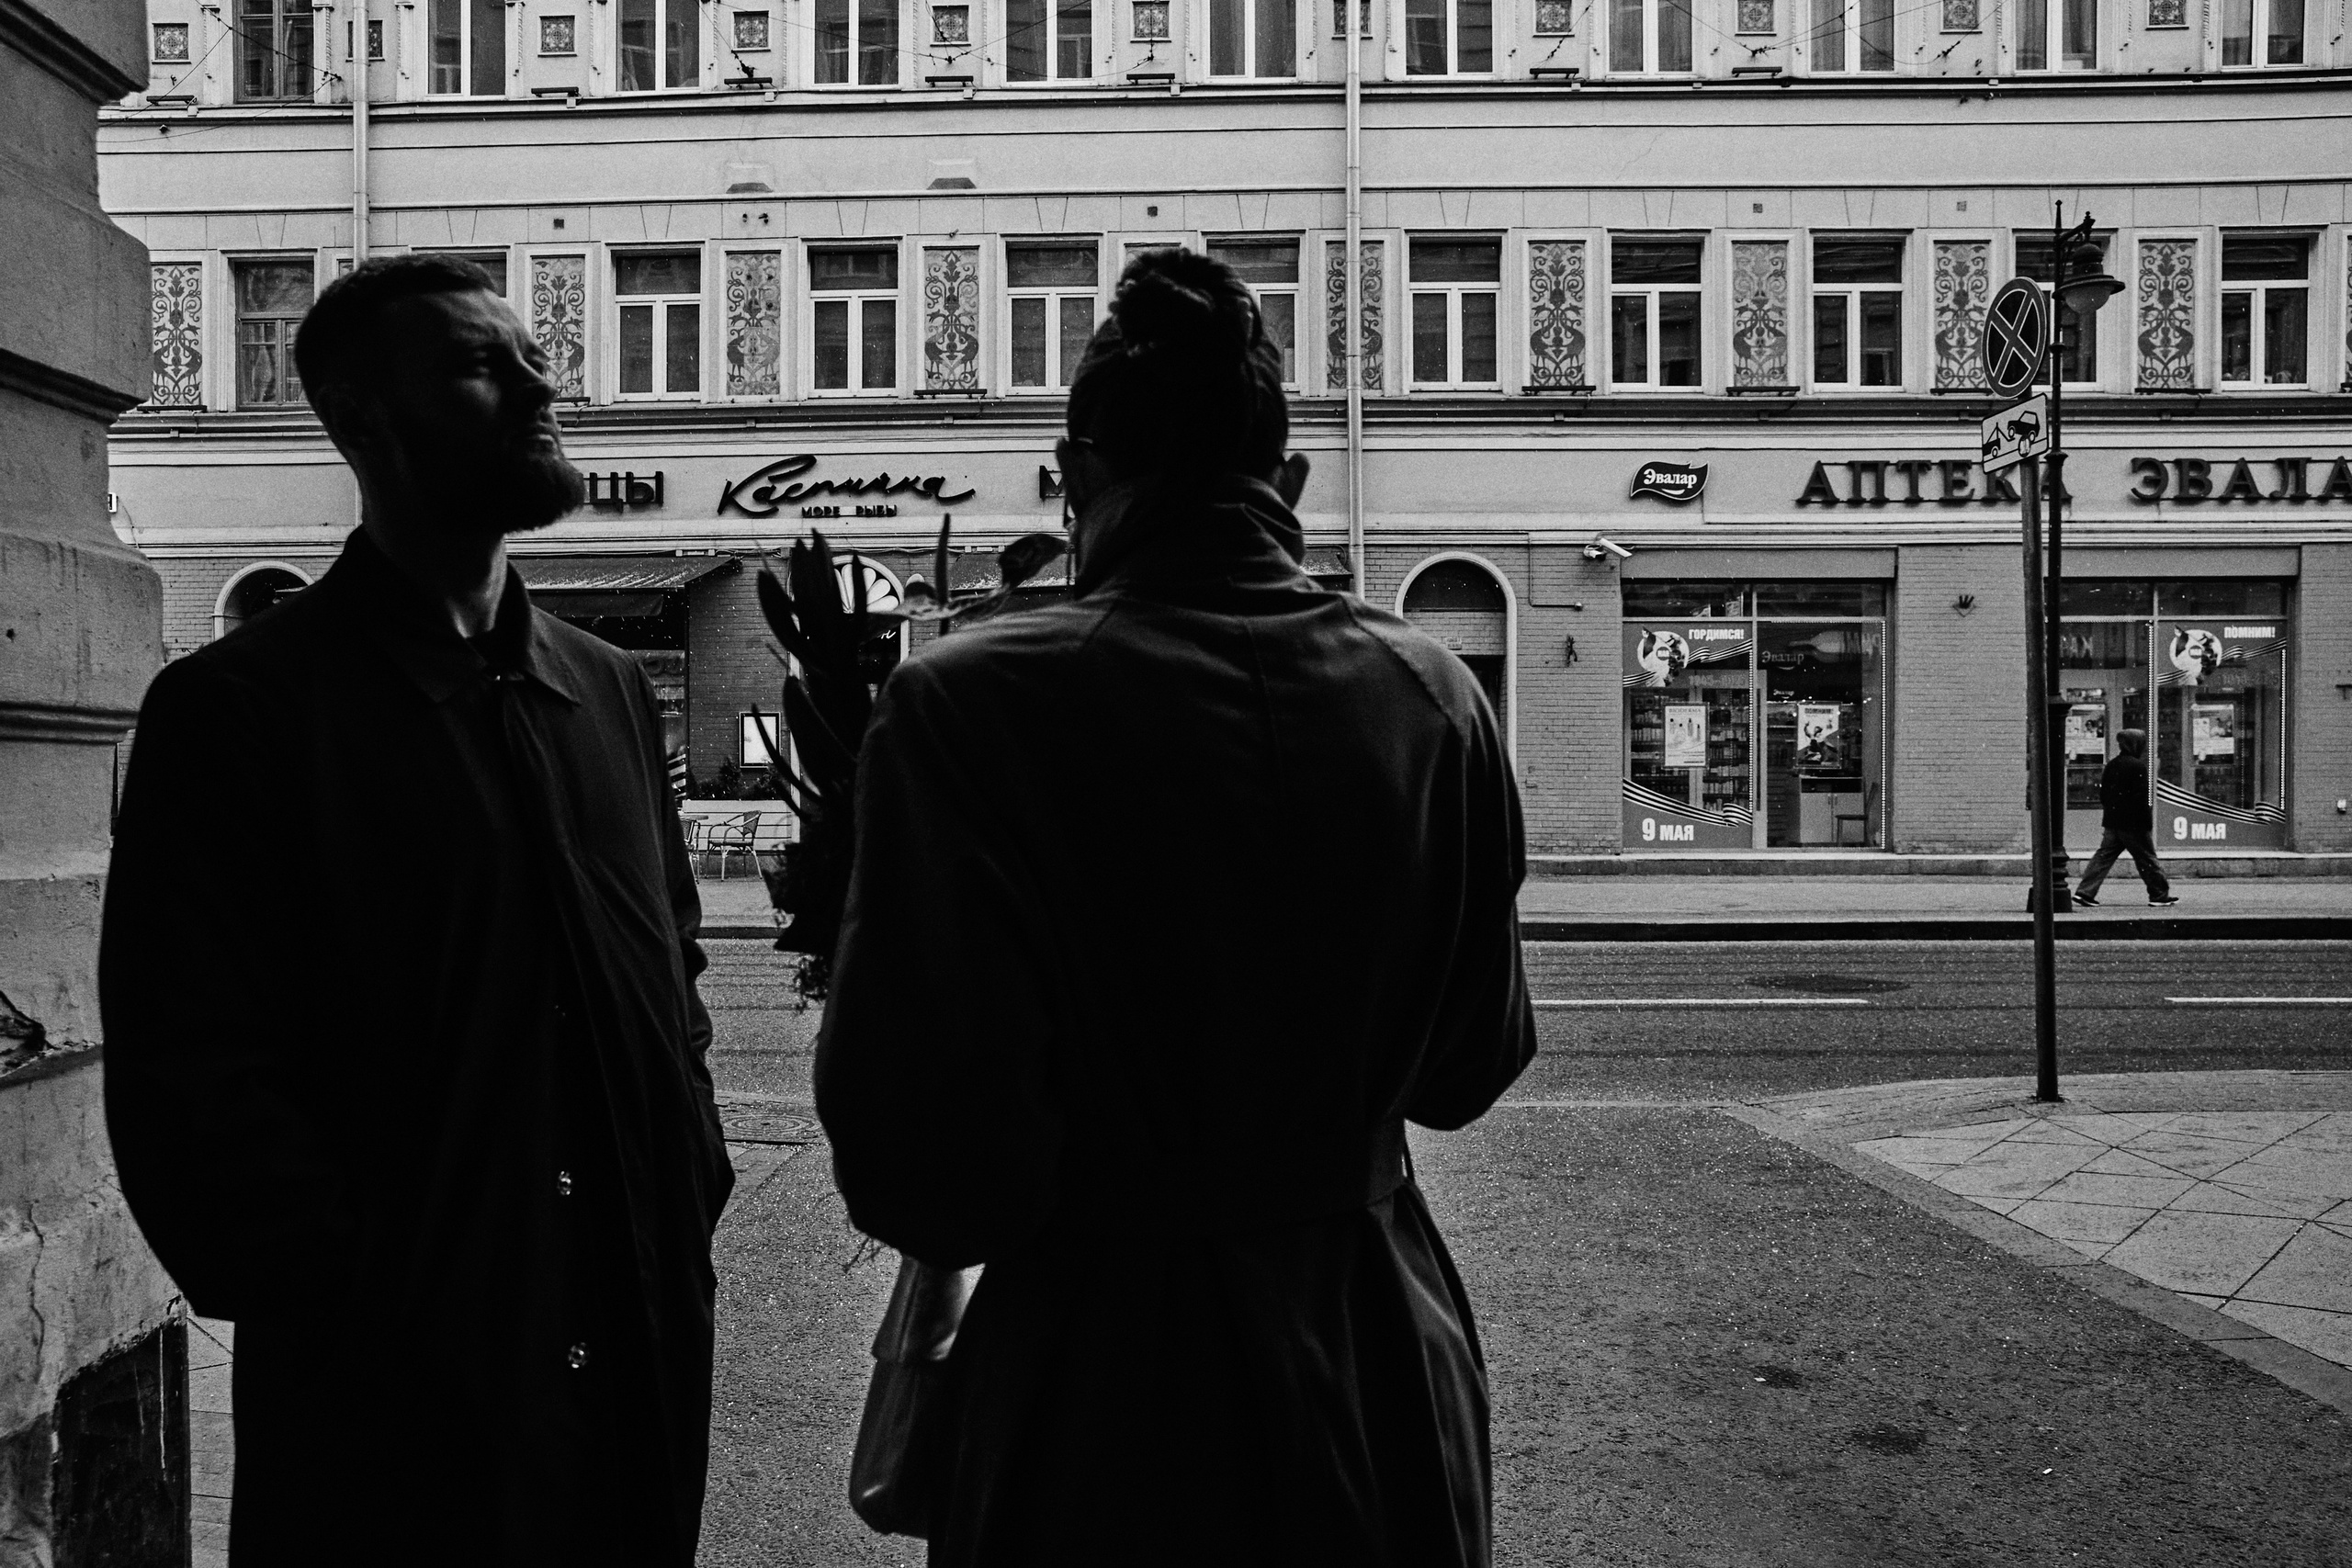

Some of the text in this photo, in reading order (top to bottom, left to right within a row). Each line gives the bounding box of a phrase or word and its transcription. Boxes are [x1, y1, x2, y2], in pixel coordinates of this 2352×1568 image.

[1643, 468, 1698, 489] Эвалар
[2131, 456, 2352, 502] ЭВАЛА
[584, 471, 663, 512] ЦЫ
[802, 505, 897, 517] МОРЕ РЫБЫ
[1689, 628, 1745, 641] ГОРДИМСЯ!
[2224, 626, 2276, 638] ПОМНИМ!
[1642, 818, 1694, 841] 9 МАЯ
[2174, 816, 2226, 840] 9 МАЯ
